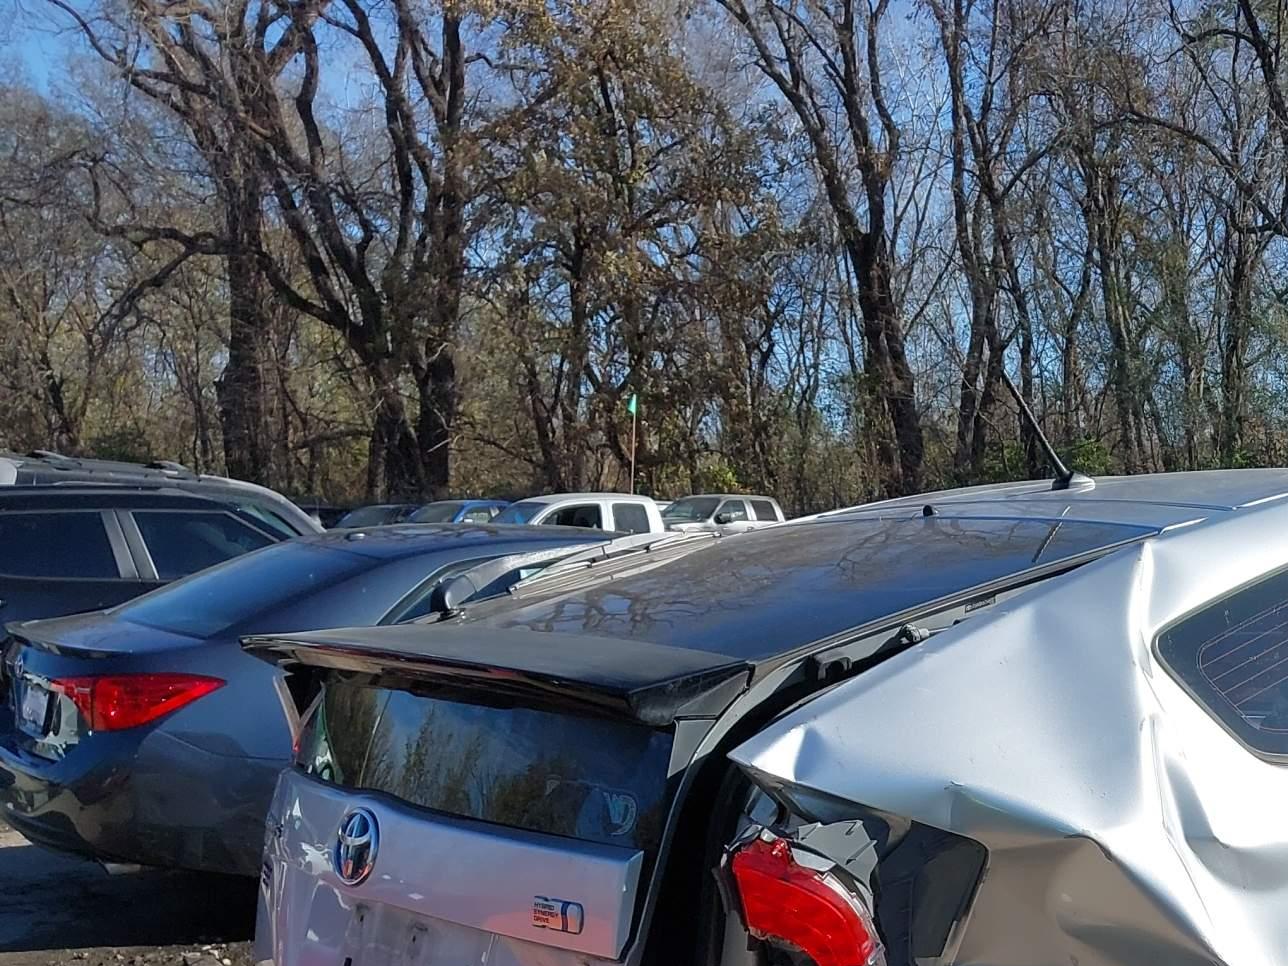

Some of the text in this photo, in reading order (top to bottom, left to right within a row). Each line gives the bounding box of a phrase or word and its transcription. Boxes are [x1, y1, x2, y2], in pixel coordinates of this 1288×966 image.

[533, 902, 555, 911] HYBRID
[533, 908, 559, 918] SYNERGY
[533, 915, 550, 924] DRIVE
